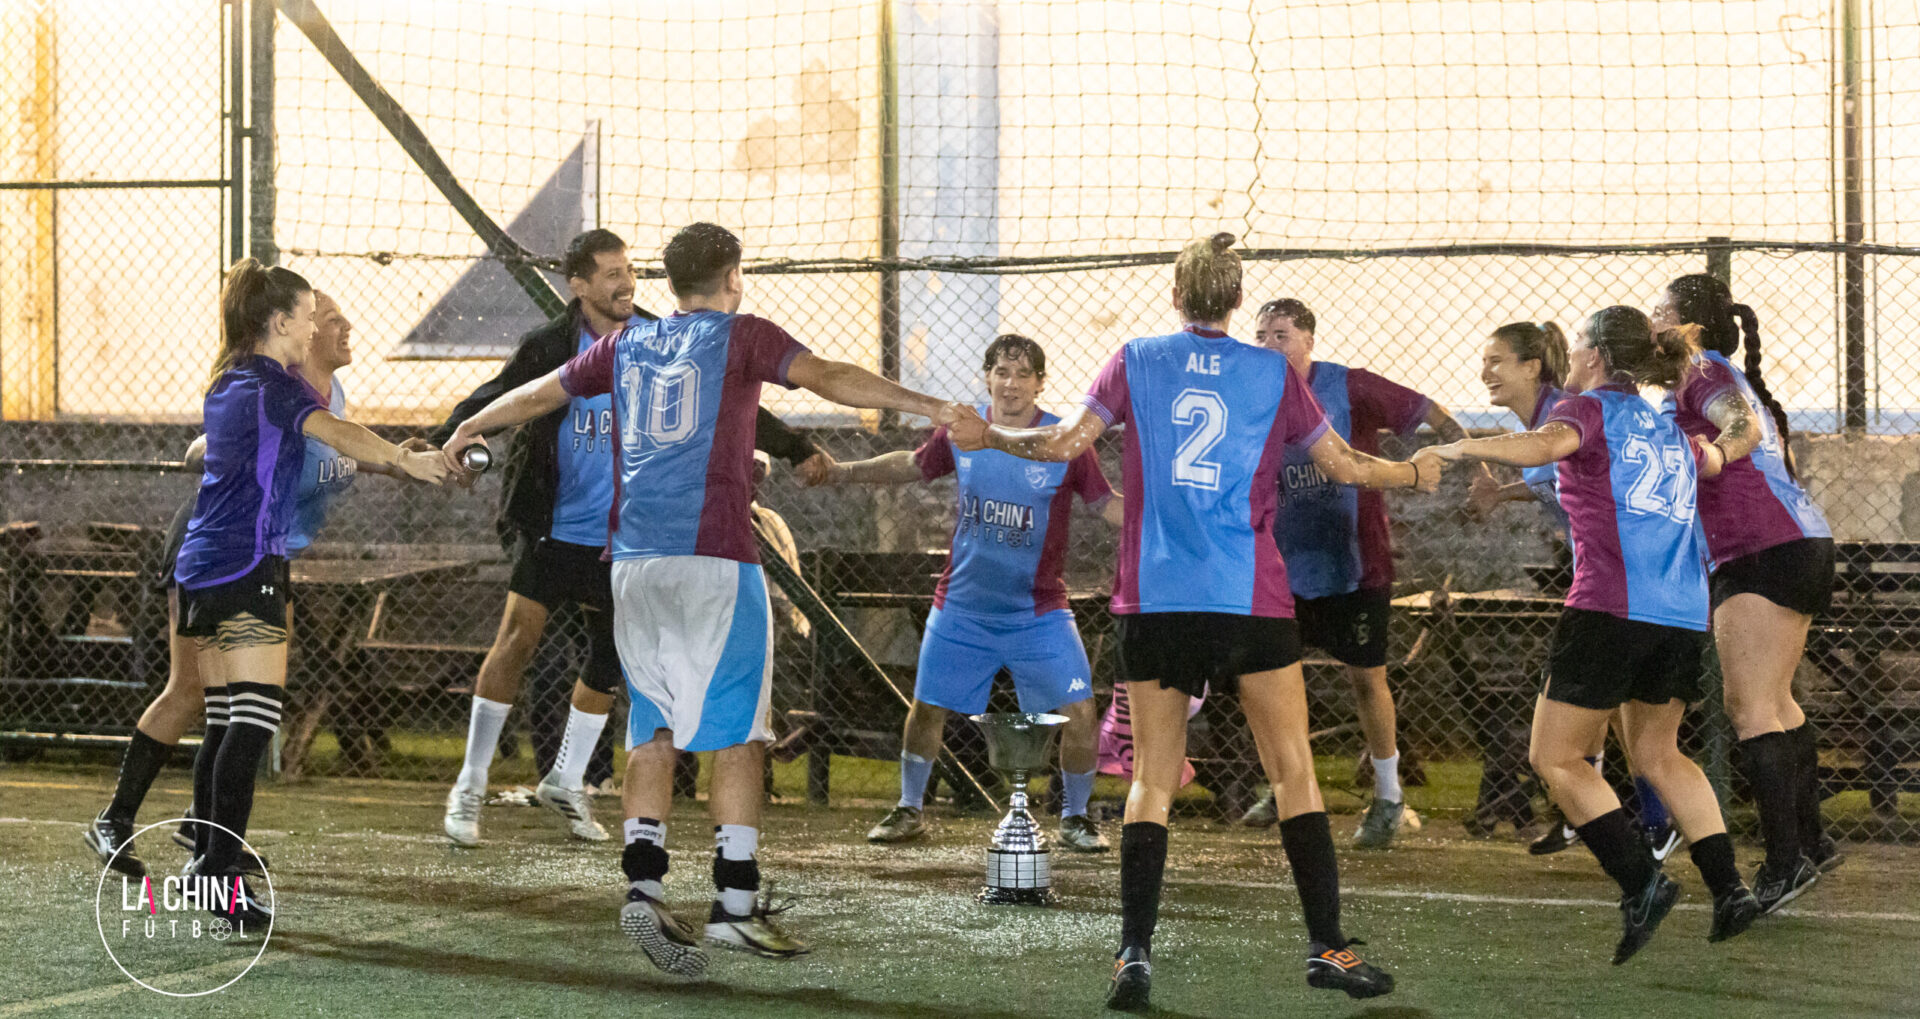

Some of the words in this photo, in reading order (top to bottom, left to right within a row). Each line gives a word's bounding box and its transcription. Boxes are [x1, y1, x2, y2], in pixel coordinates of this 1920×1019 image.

[1185, 352, 1221, 376] ALE
[620, 358, 701, 451] 10
[573, 409, 596, 438] LA
[1171, 387, 1229, 491] 2
[318, 458, 336, 484] LA
[1621, 432, 1696, 527] 22
[963, 493, 980, 524] LA
[983, 499, 1034, 531] CHINA
[629, 829, 662, 840] SPORT
